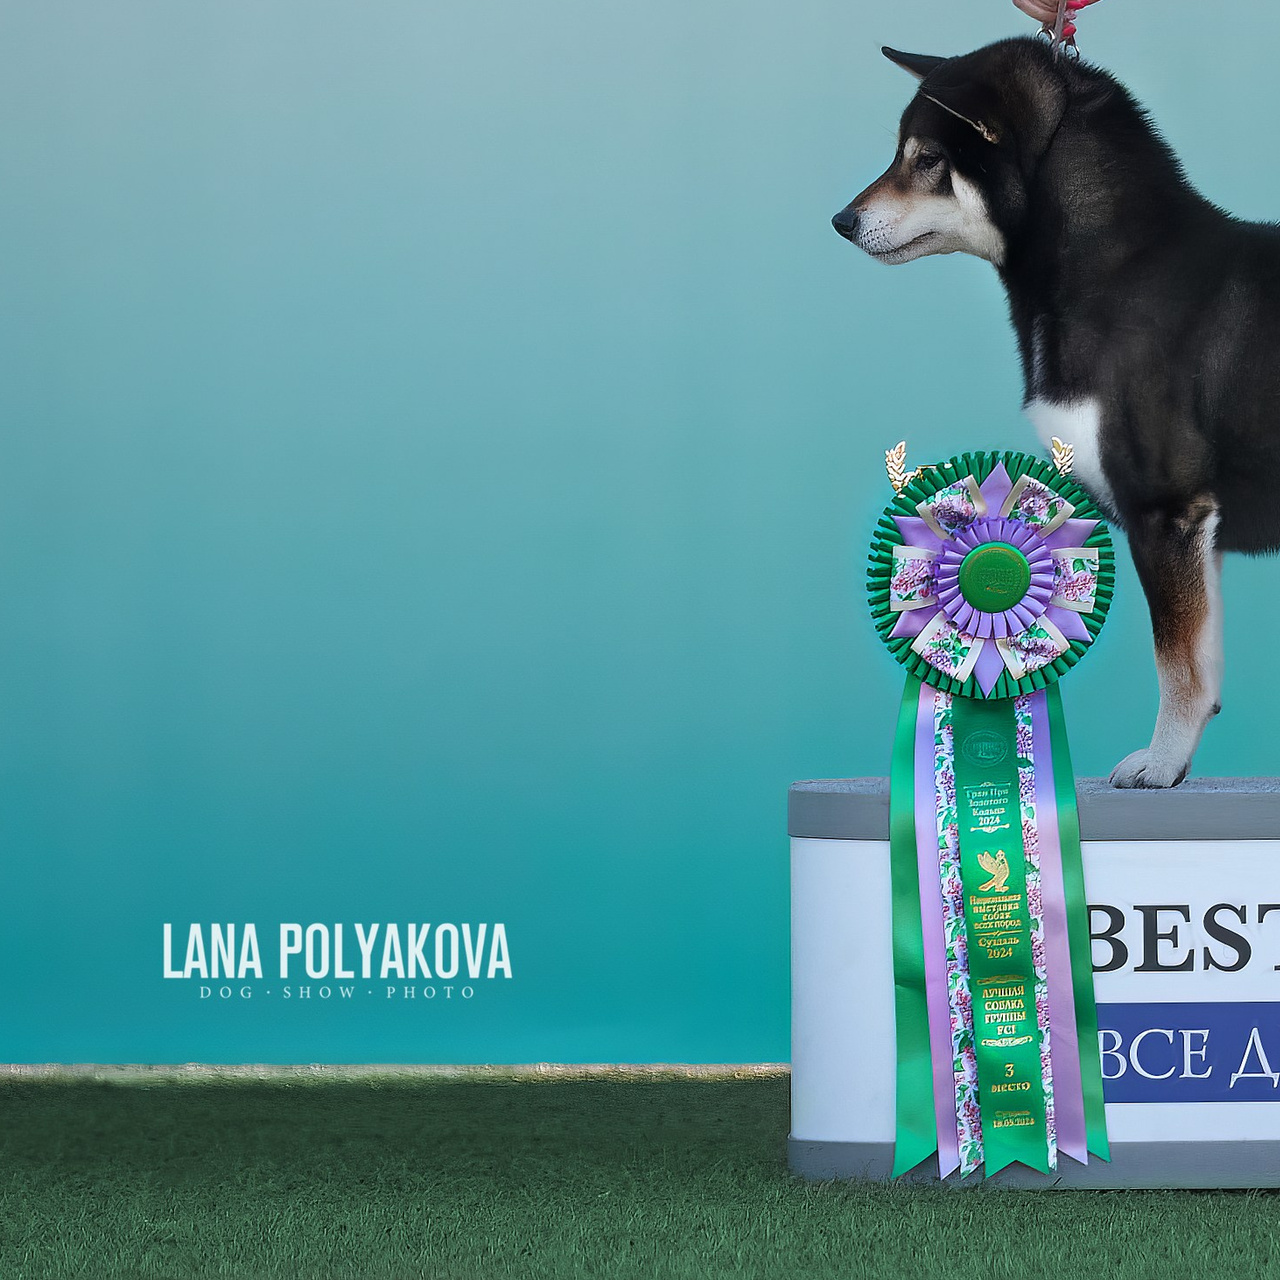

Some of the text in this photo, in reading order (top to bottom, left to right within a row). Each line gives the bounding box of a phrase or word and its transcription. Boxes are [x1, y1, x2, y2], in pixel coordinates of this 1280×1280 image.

[979, 816, 1001, 826] 2024
[982, 912, 1012, 921] собак
[987, 947, 1013, 959] 2024
[982, 985, 1025, 999] ЛУЧШАЯ
[984, 999, 1025, 1011] СОБАКА
[984, 1011, 1026, 1024] ГРУППЫ
[997, 1025, 1016, 1036] FCI
[1097, 1028, 1213, 1080] ВСЕ
[1005, 1063, 1015, 1078] 3
